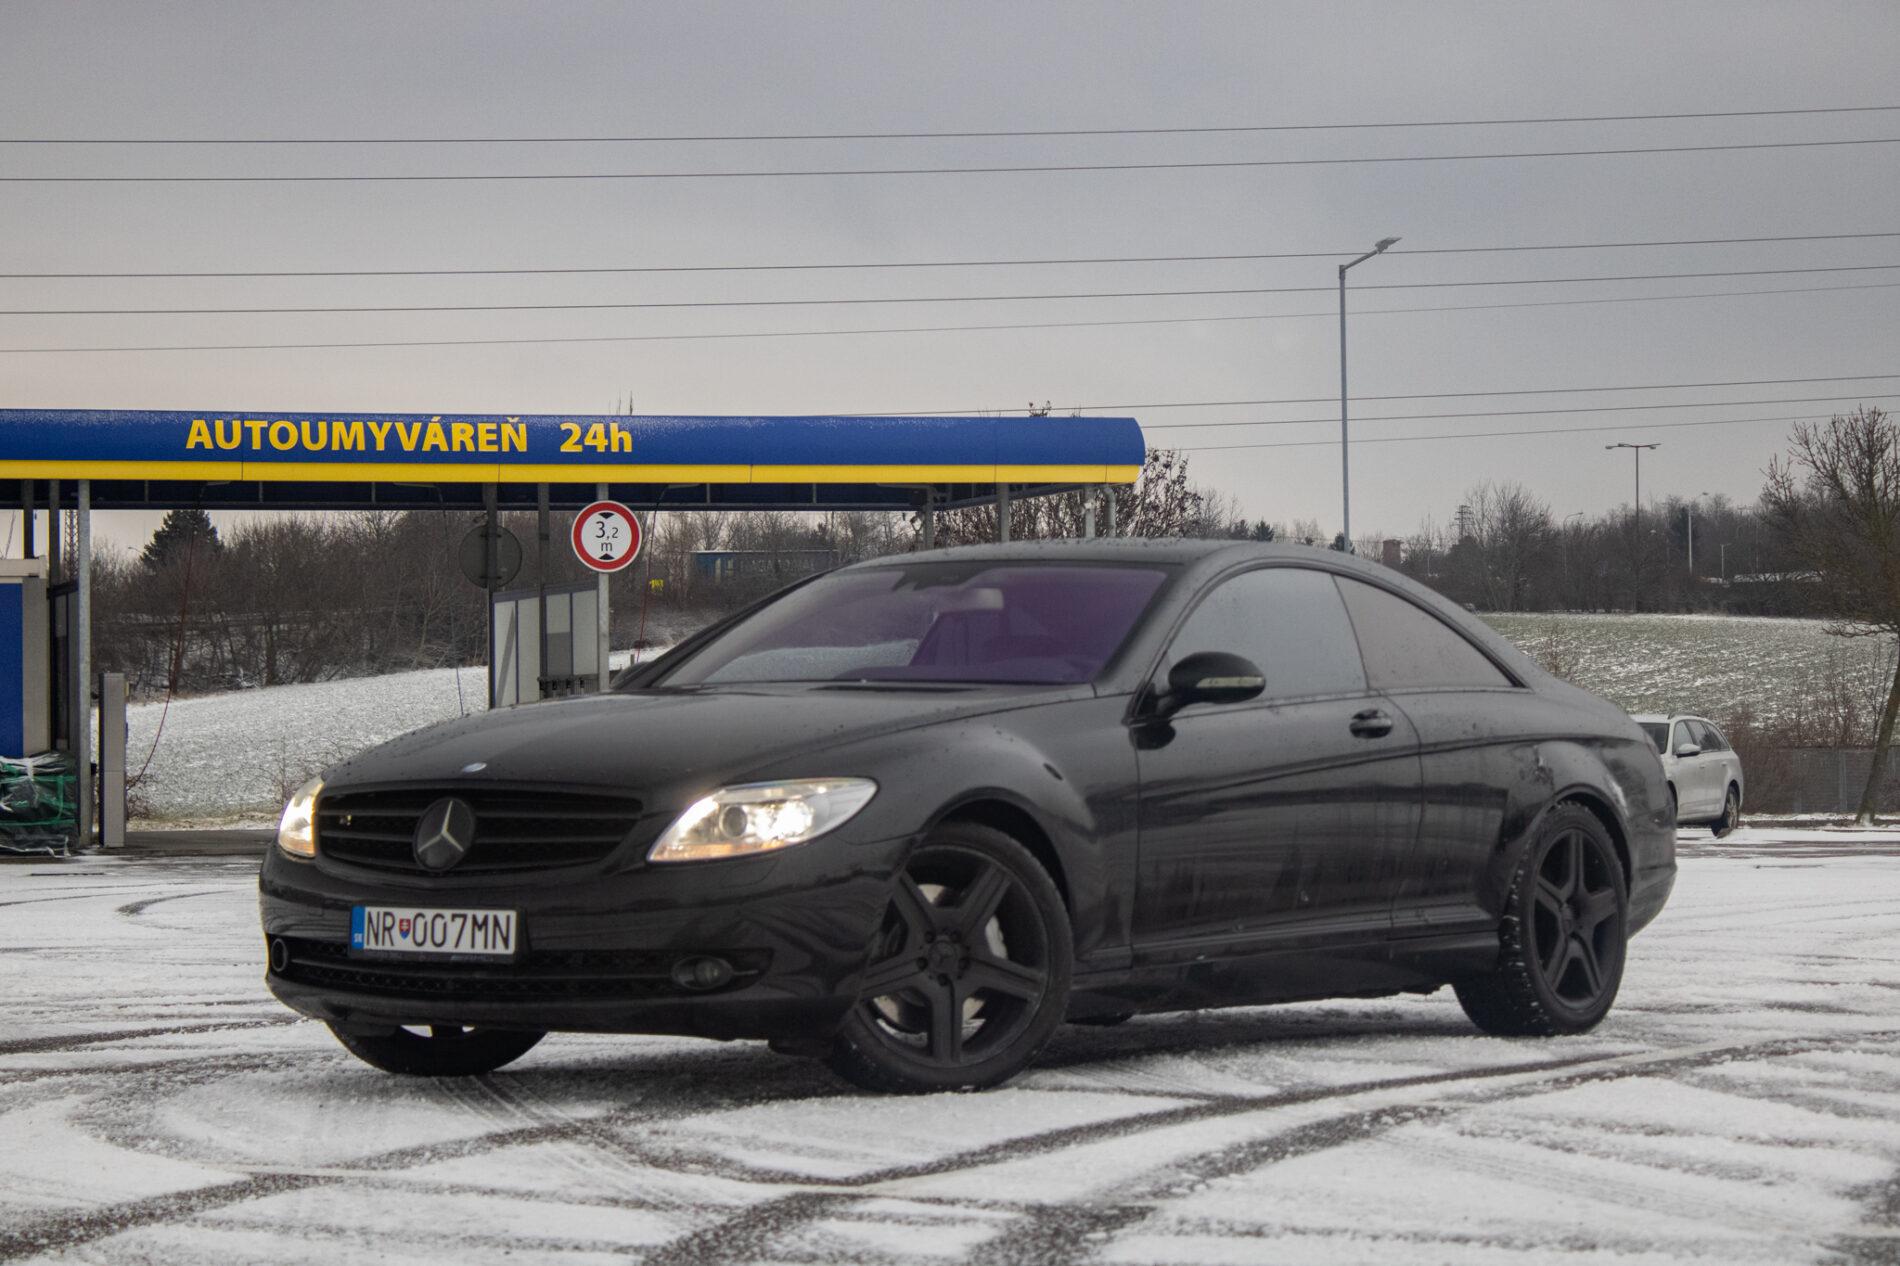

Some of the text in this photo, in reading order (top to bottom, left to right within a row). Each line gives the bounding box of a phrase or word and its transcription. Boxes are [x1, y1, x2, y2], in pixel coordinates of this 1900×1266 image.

[185, 416, 633, 453] AUTOUMYVÁREŇ 24h
[595, 520, 619, 540] 3,2
[600, 542, 613, 552] m
[366, 911, 511, 950] NR 007MN
